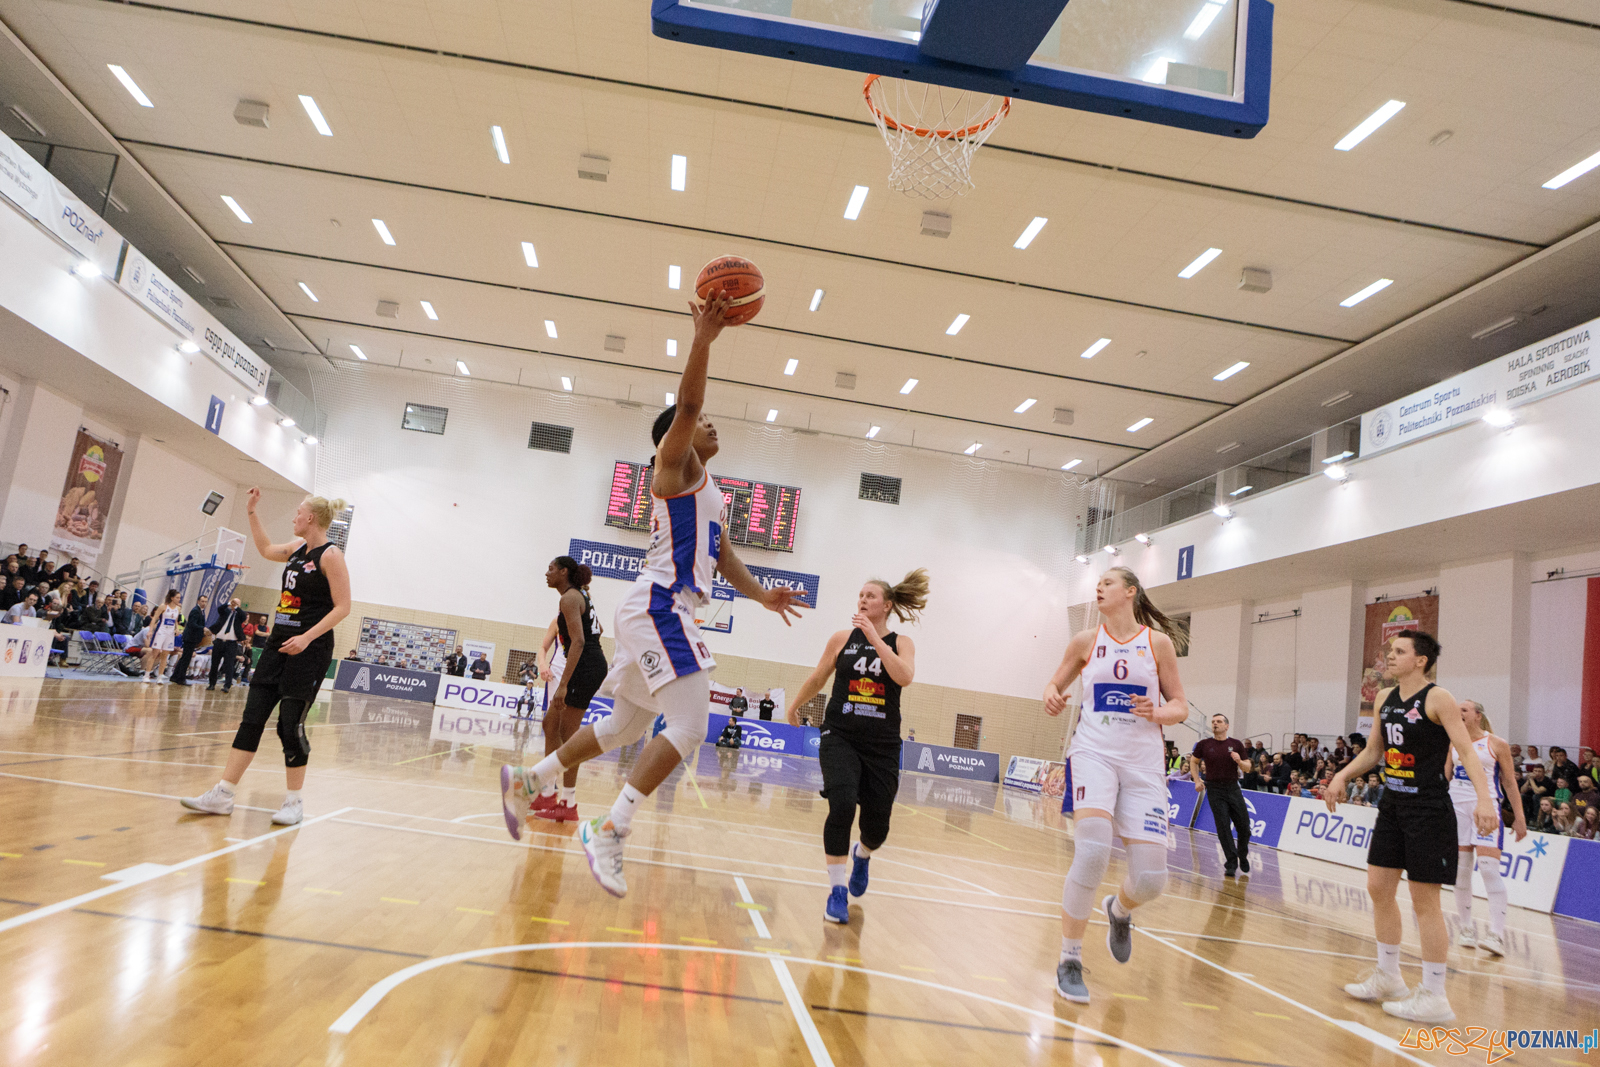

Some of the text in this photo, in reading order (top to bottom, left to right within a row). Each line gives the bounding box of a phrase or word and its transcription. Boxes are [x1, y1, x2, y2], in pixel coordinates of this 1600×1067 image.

[707, 260, 749, 275] molten
[722, 279, 739, 288] FIBA
[204, 327, 267, 387] cspp.put.poznan.pl
[1507, 330, 1591, 373] HALA SPORTOWA
[1506, 359, 1591, 401] BOISKA AEROBIK
[1398, 411, 1442, 436] Politechniki
[1445, 390, 1497, 419] Poznańskiej
[1399, 387, 1461, 418] Centrum Sportu
[211, 403, 221, 430] 1
[1181, 550, 1188, 576] 1
[284, 570, 299, 590] 15
[714, 591, 731, 599] Enea
[853, 656, 883, 677] 44
[1112, 658, 1129, 681] 6
[374, 673, 427, 688] AVENIDA
[385, 684, 413, 692] POZNAŃ
[1385, 722, 1404, 746] 16
[937, 753, 986, 767] AVENIDA
[948, 763, 974, 772] POZNAŃ
